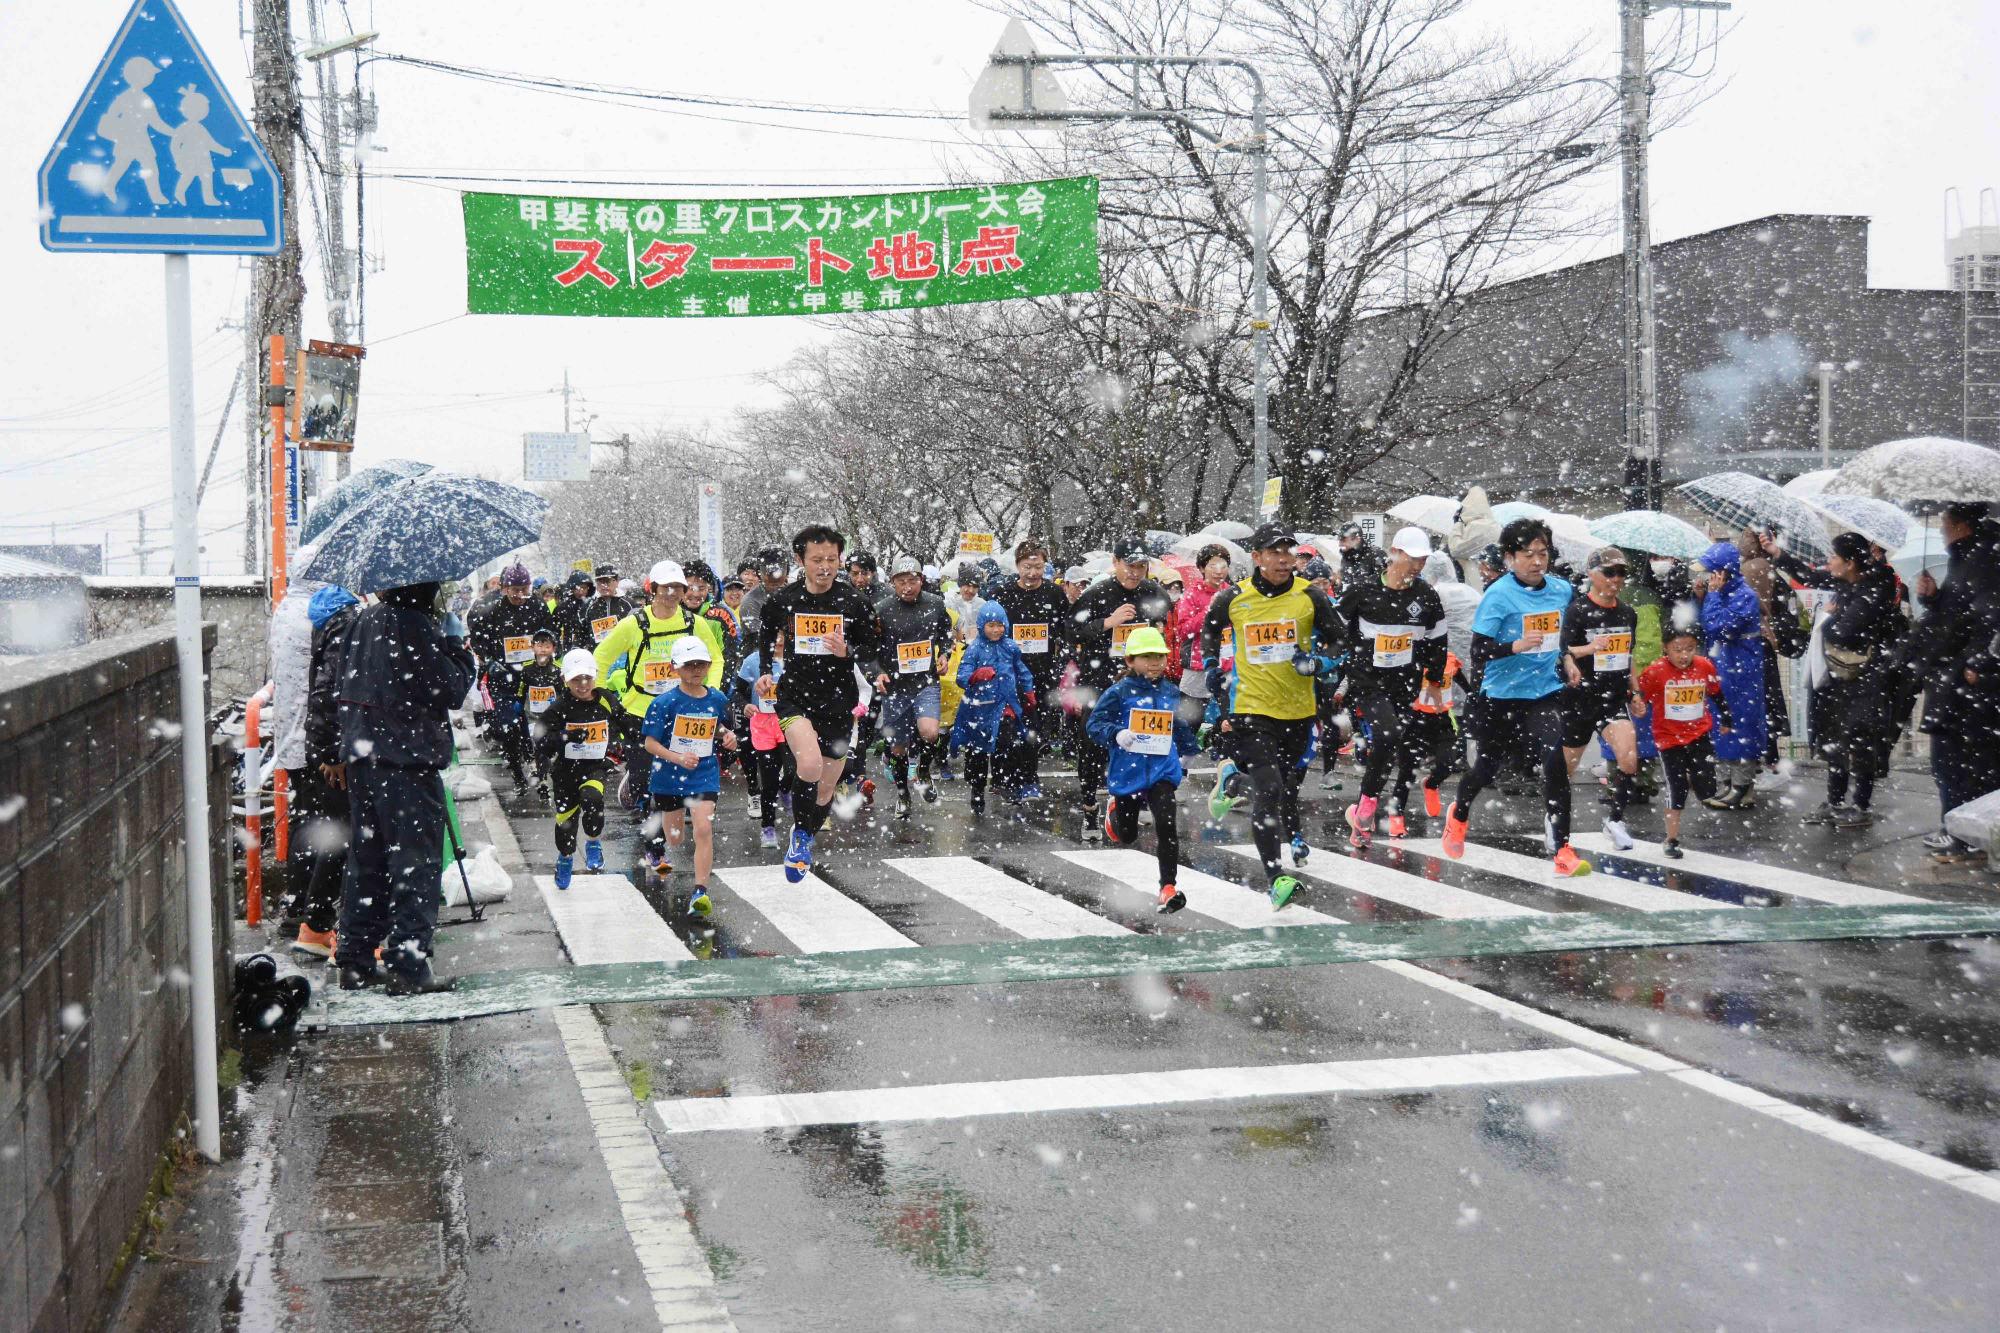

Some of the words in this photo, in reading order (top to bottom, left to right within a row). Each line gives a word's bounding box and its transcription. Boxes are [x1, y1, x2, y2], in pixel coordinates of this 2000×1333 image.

[519, 185, 1047, 235] 甲斐梅の里クロスカントリー大会
[552, 224, 1026, 289] スタート地点
[805, 619, 827, 634] 136
[1256, 626, 1279, 642] 144
[904, 646, 922, 657] 116
[652, 665, 672, 678] 142
[1674, 690, 1693, 703] 237
[684, 721, 706, 737] 136
[1141, 715, 1163, 731] 144
